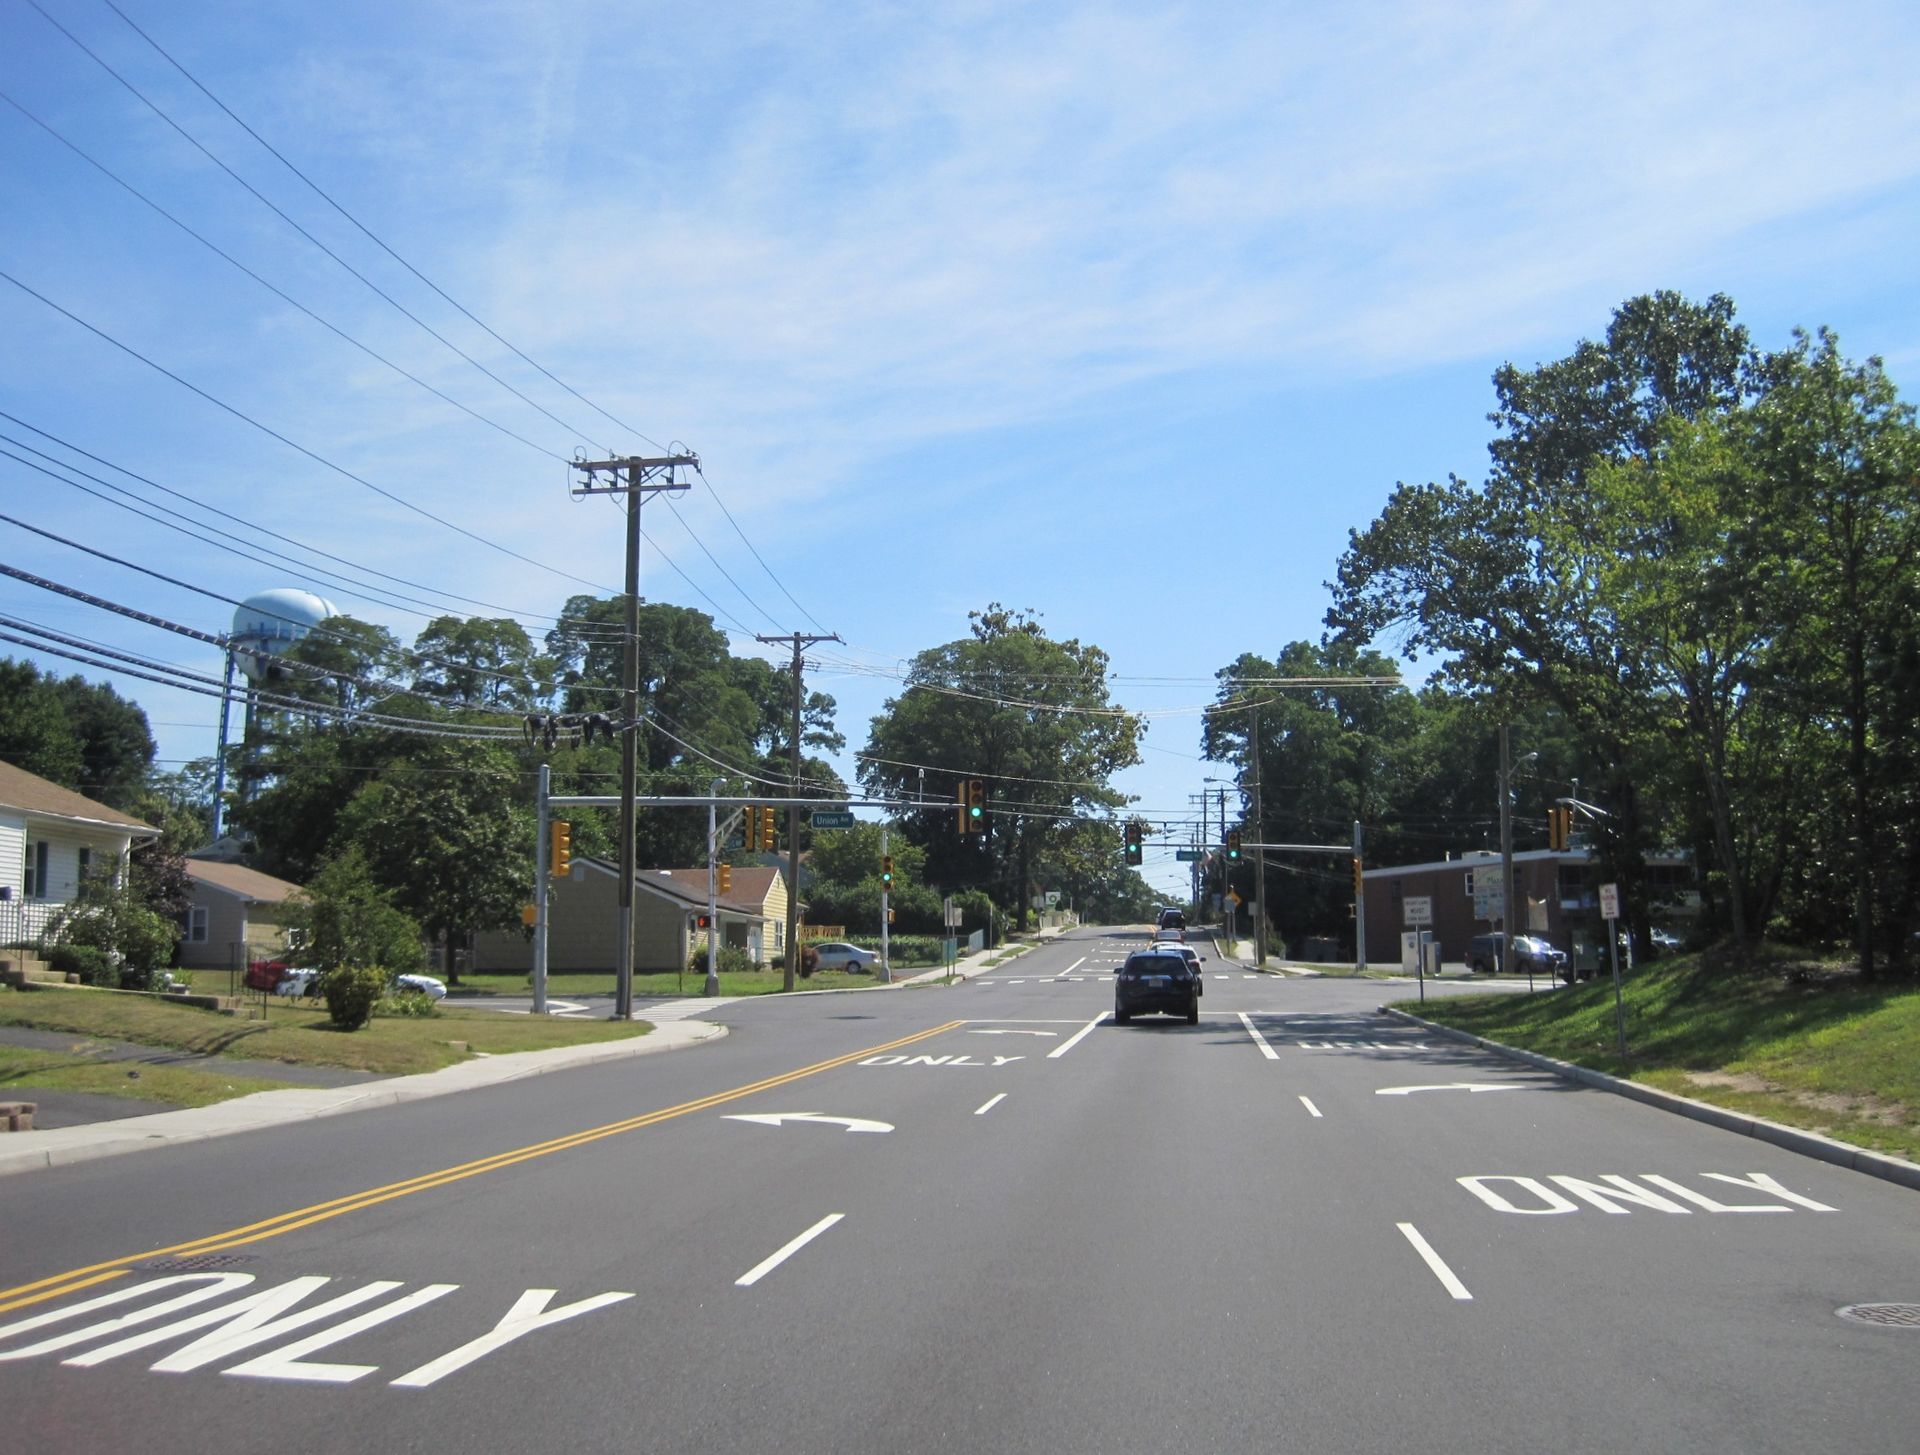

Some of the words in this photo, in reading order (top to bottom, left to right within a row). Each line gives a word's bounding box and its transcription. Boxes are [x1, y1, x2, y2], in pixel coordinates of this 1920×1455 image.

[816, 816, 839, 825] Union
[857, 1055, 1027, 1066] ONLY
[1456, 1173, 1841, 1215] ONLY
[0, 1272, 636, 1388] ONLY
